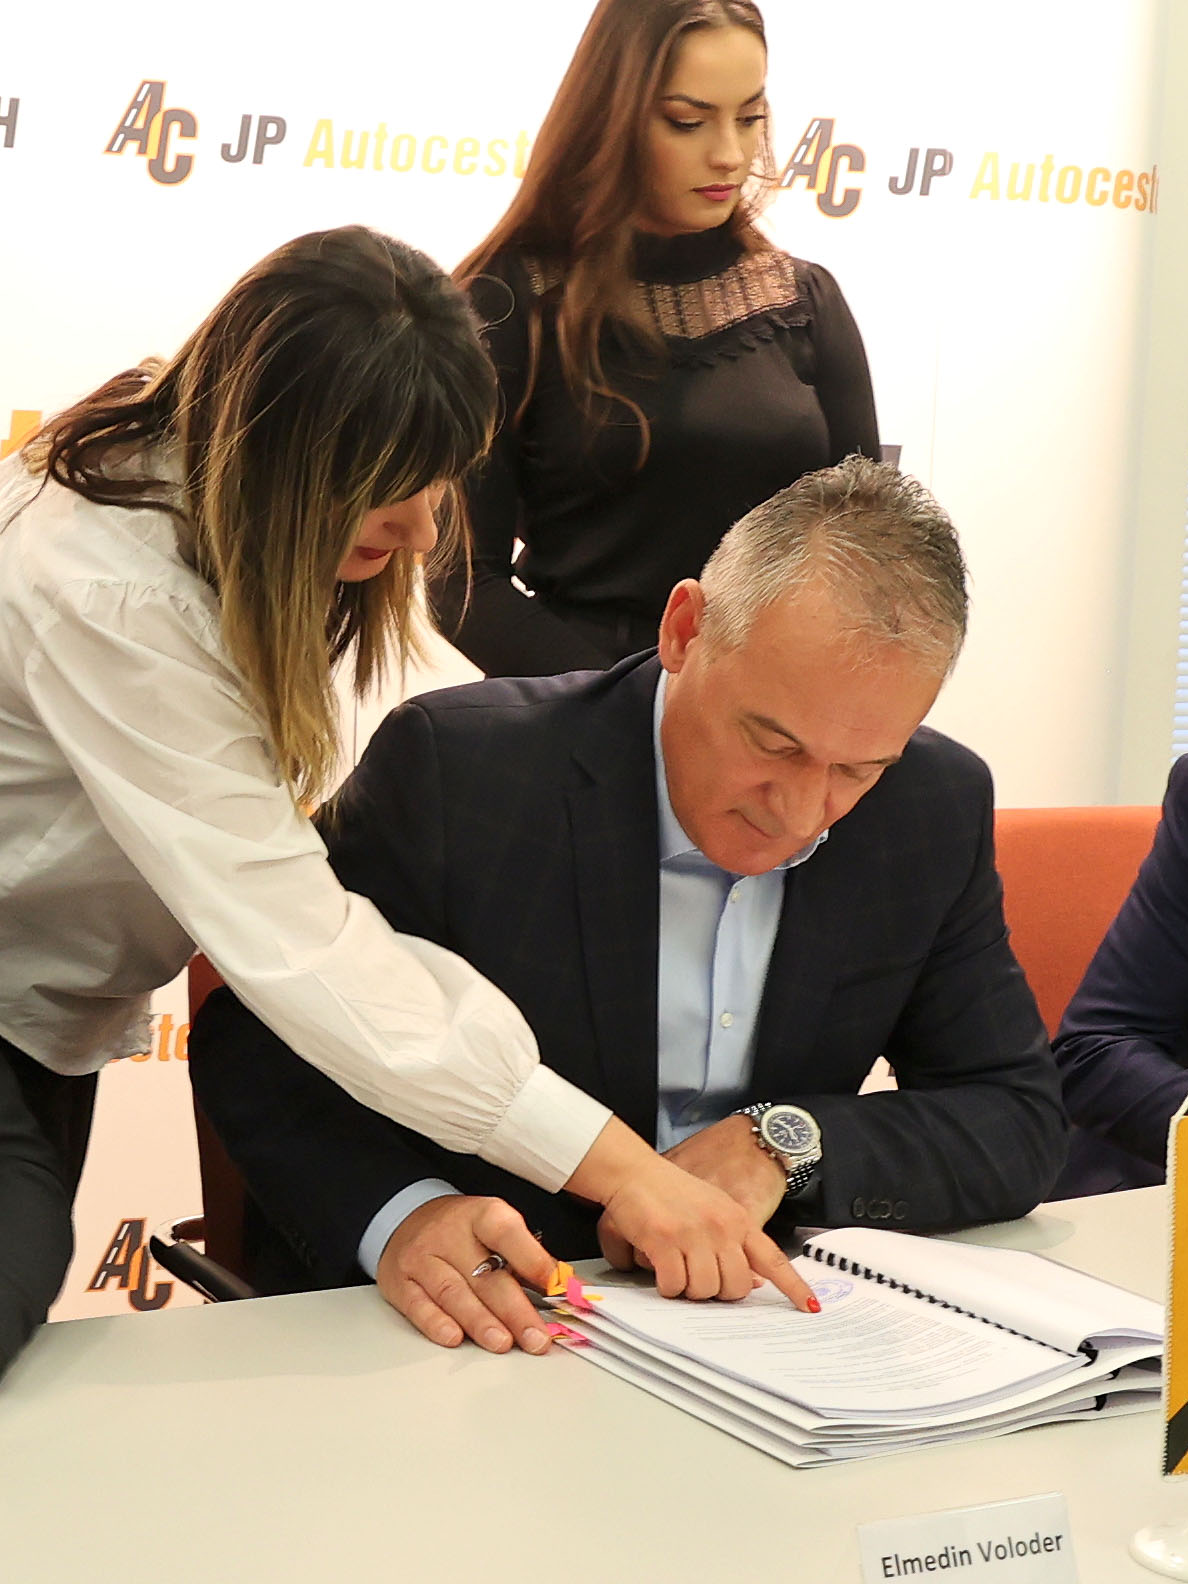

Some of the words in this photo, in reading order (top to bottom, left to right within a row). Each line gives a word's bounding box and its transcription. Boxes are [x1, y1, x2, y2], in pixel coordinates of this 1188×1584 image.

[103, 79, 198, 186] AC
[220, 114, 287, 164] JP
[779, 117, 866, 219] AC
[888, 148, 953, 196] JP
[881, 1546, 973, 1578] Elmedin
[976, 1532, 1063, 1562] Voloder
